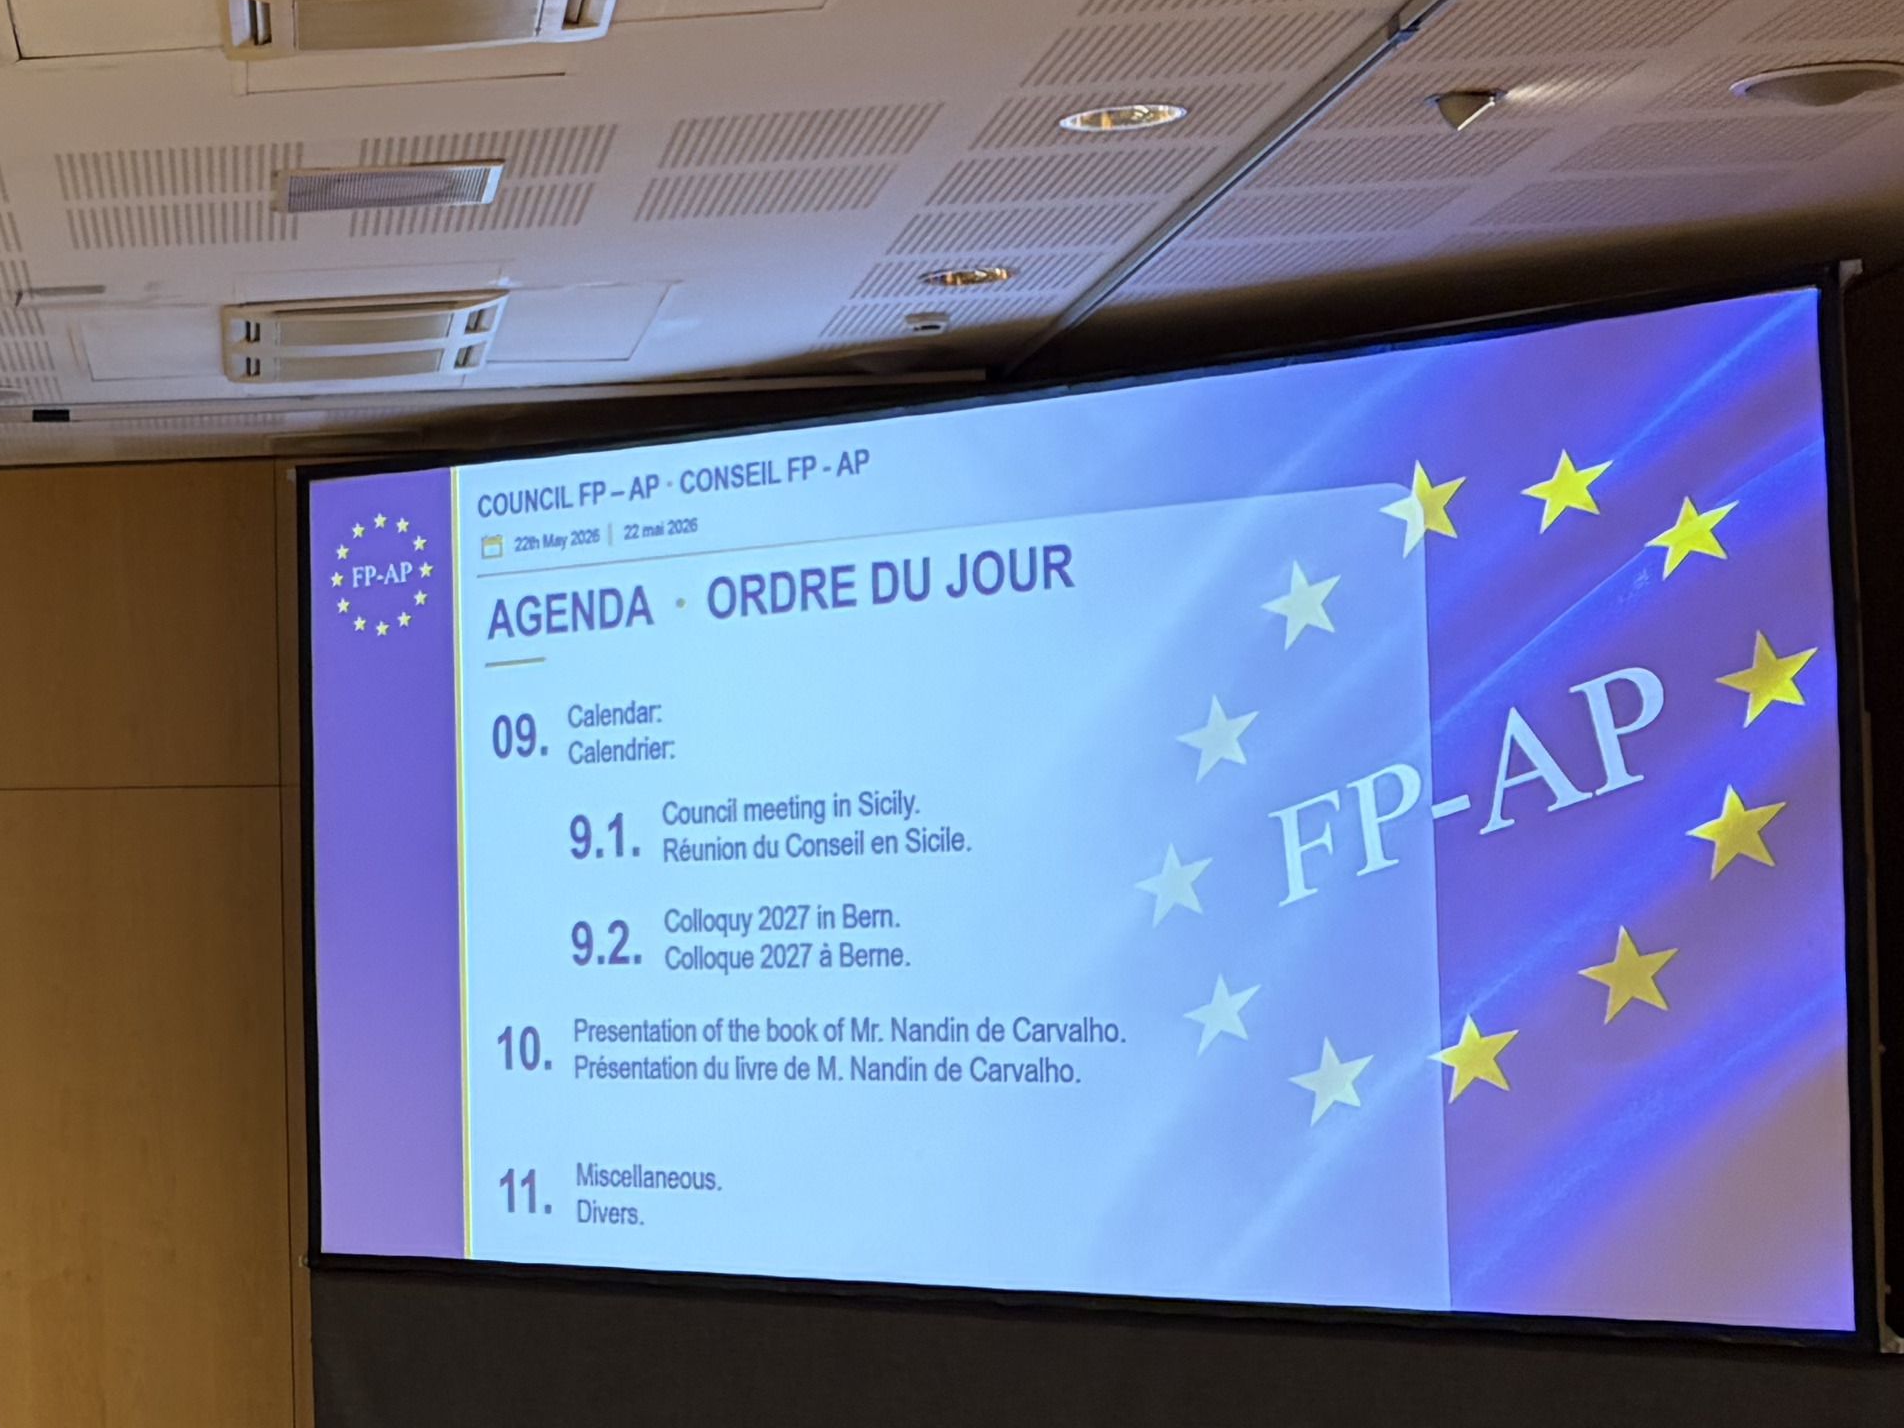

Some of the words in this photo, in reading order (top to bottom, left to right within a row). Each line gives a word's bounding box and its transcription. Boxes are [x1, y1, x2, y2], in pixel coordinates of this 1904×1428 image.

[477, 486, 574, 518] COUNCIL
[579, 481, 606, 507] FP
[628, 474, 660, 501] AP
[679, 461, 782, 494] CONSEIL
[787, 455, 817, 483] FP
[836, 448, 870, 477] AP
[542, 532, 568, 551] May
[570, 528, 601, 546] 2026
[623, 523, 640, 540] 22
[642, 520, 665, 538] mai
[667, 517, 699, 535] 2026
[352, 561, 413, 588] FP-AP
[487, 585, 655, 640] AGENDA
[706, 564, 858, 620] ORDRE
[871, 556, 931, 605] DU
[944, 543, 1076, 600] JOUR
[567, 699, 663, 729] Calendar:
[492, 712, 550, 760] 09.
[568, 737, 676, 766] Calendrier:
[1267, 667, 1665, 908] FP-AP
[662, 797, 738, 825] Council
[743, 794, 826, 824] meeting
[832, 792, 852, 819] in
[858, 789, 921, 819] Sicily.
[569, 812, 641, 860] 9.1.
[663, 835, 748, 863] Réunion
[753, 834, 780, 860] du
[785, 830, 865, 859] Conseil
[871, 834, 899, 855] en
[905, 826, 973, 854] Sicile.
[664, 907, 753, 938] Colloquy
[758, 904, 811, 931] 2027
[816, 903, 836, 929] in
[842, 903, 901, 929] Bern.
[571, 919, 643, 967] 9.2.
[664, 945, 754, 975] Colloque
[760, 943, 813, 969] 2027
[818, 943, 834, 968] à
[839, 942, 912, 968] Berne.
[573, 1017, 697, 1044] Presentation
[702, 1017, 725, 1043] of
[728, 1017, 761, 1043] the
[766, 1017, 818, 1043] book
[823, 1017, 846, 1043] of
[850, 1018, 885, 1044] Mr.
[891, 1016, 970, 1043] Nandin
[976, 1016, 1006, 1044] de
[1012, 1015, 1127, 1044] Carvalho.
[497, 1025, 553, 1072] 10.
[573, 1054, 698, 1081] Présentation
[703, 1055, 730, 1081] du
[735, 1055, 779, 1082] livre
[784, 1055, 811, 1082] de
[816, 1056, 844, 1083] M.
[850, 1056, 927, 1083] Nandin
[934, 1056, 963, 1083] de
[969, 1056, 1082, 1084] Carvalho.
[498, 1167, 553, 1214] 11.
[575, 1162, 723, 1192] Miscellaneous.
[576, 1199, 646, 1227] Divers.
